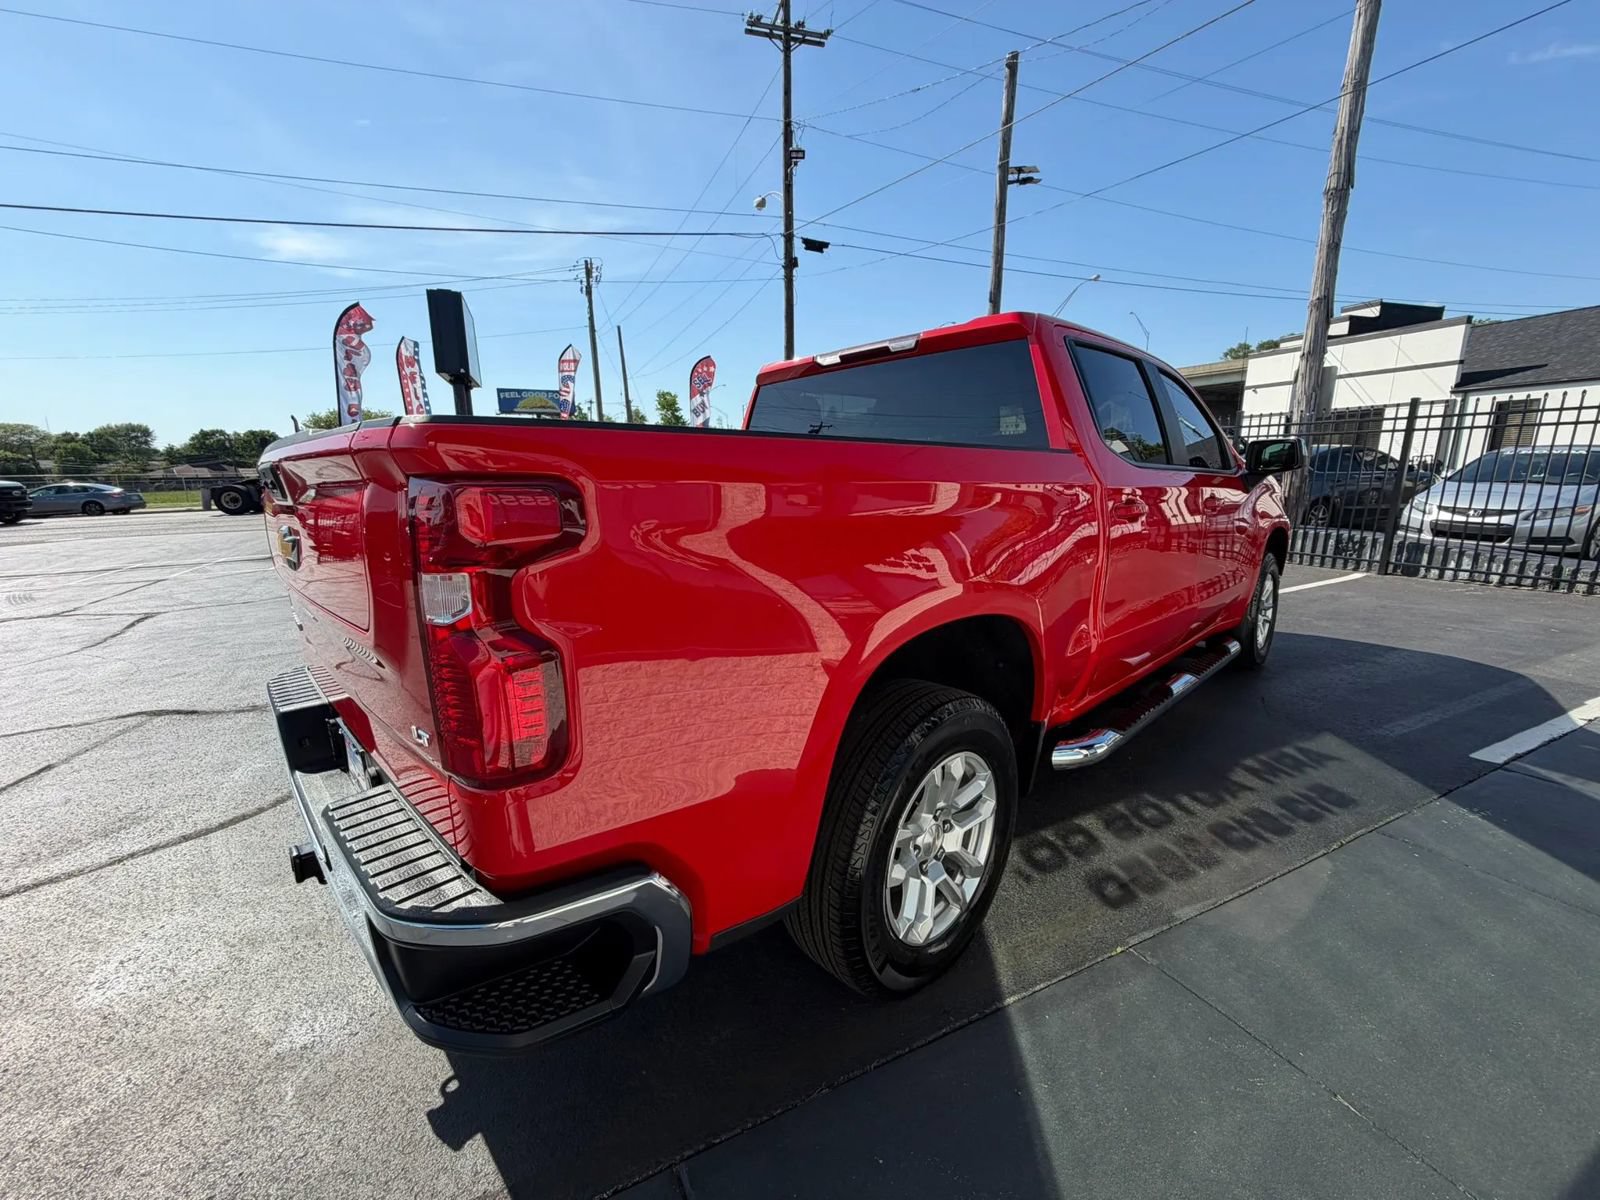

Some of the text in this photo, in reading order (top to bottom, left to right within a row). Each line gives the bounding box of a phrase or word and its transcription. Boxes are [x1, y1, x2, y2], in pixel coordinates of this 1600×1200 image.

[500, 391, 520, 399] FEEL
[521, 391, 547, 399] GOOD
[692, 400, 708, 418] BUY
[411, 725, 430, 747] LT
